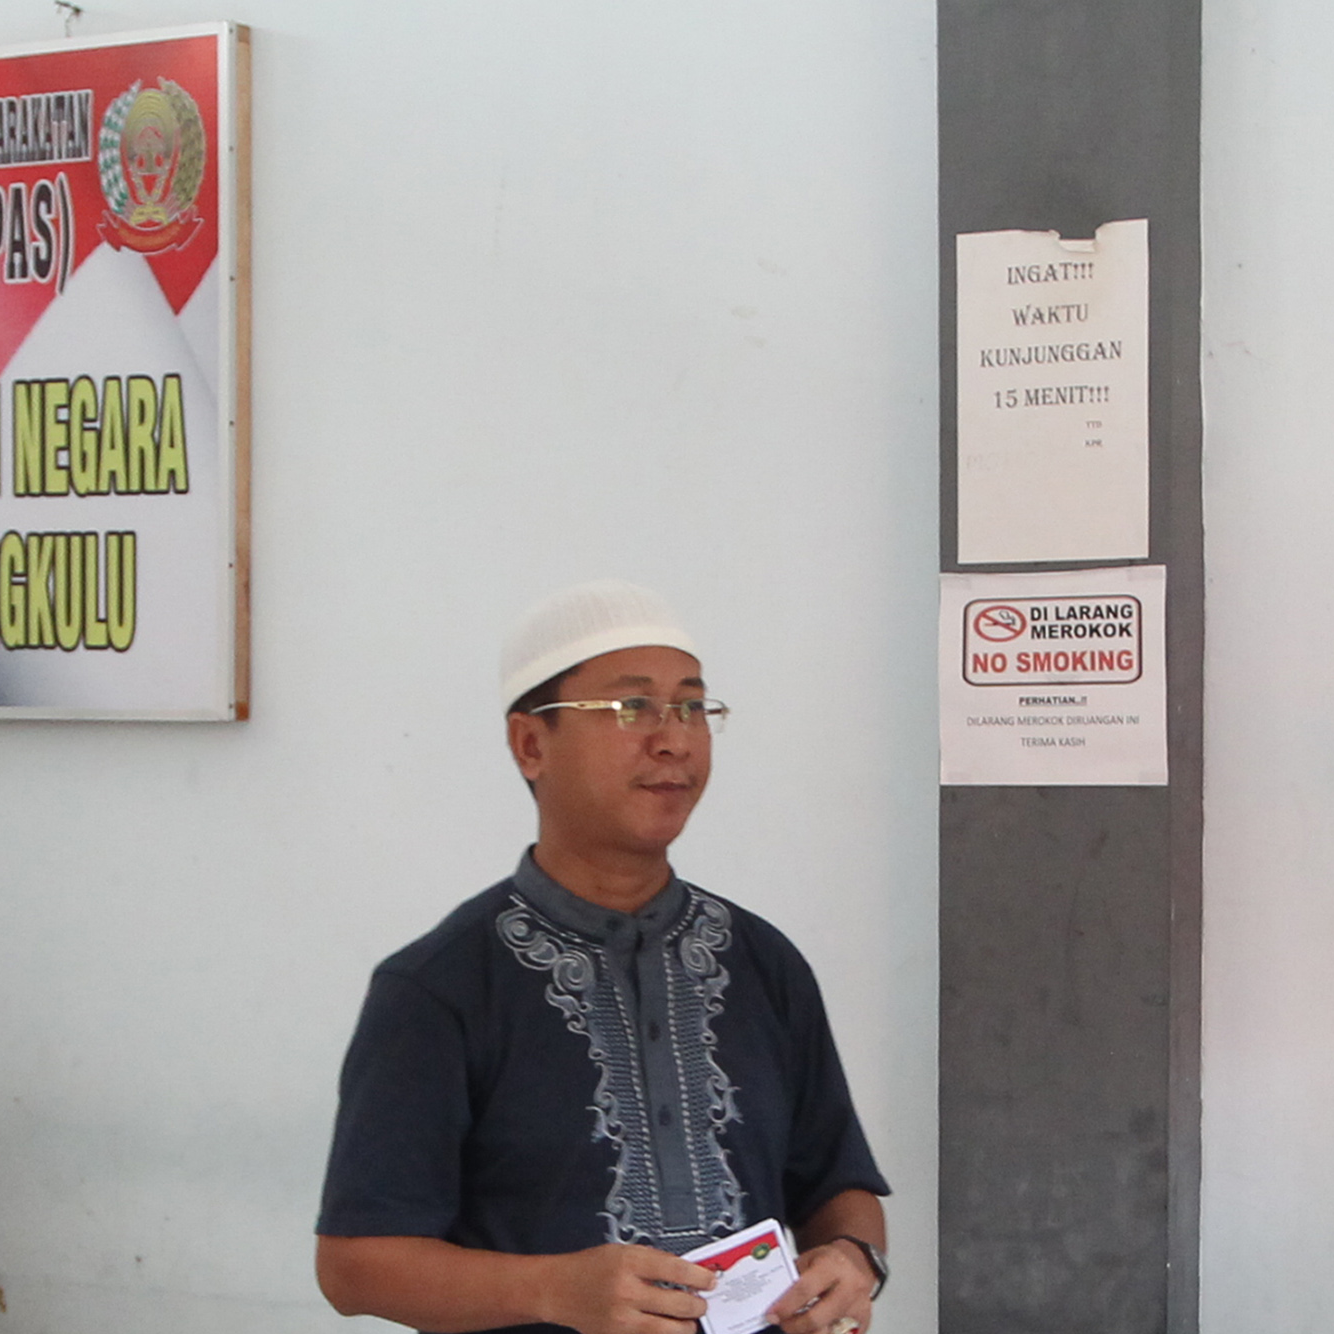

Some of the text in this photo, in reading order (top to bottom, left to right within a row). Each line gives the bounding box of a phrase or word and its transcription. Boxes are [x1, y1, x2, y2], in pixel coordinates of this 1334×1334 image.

[1007, 262, 1094, 285] INGAT!!!
[1013, 304, 1089, 326] WAKTU
[979, 340, 1122, 368] KUNJUNGGAN
[993, 385, 1110, 409] 15 MENIT!!!
[12, 373, 190, 497] NEGARA
[1030, 604, 1133, 621] DI LARANG
[1030, 622, 1133, 640] MEROKOK
[972, 650, 1134, 673] NO SMOKING
